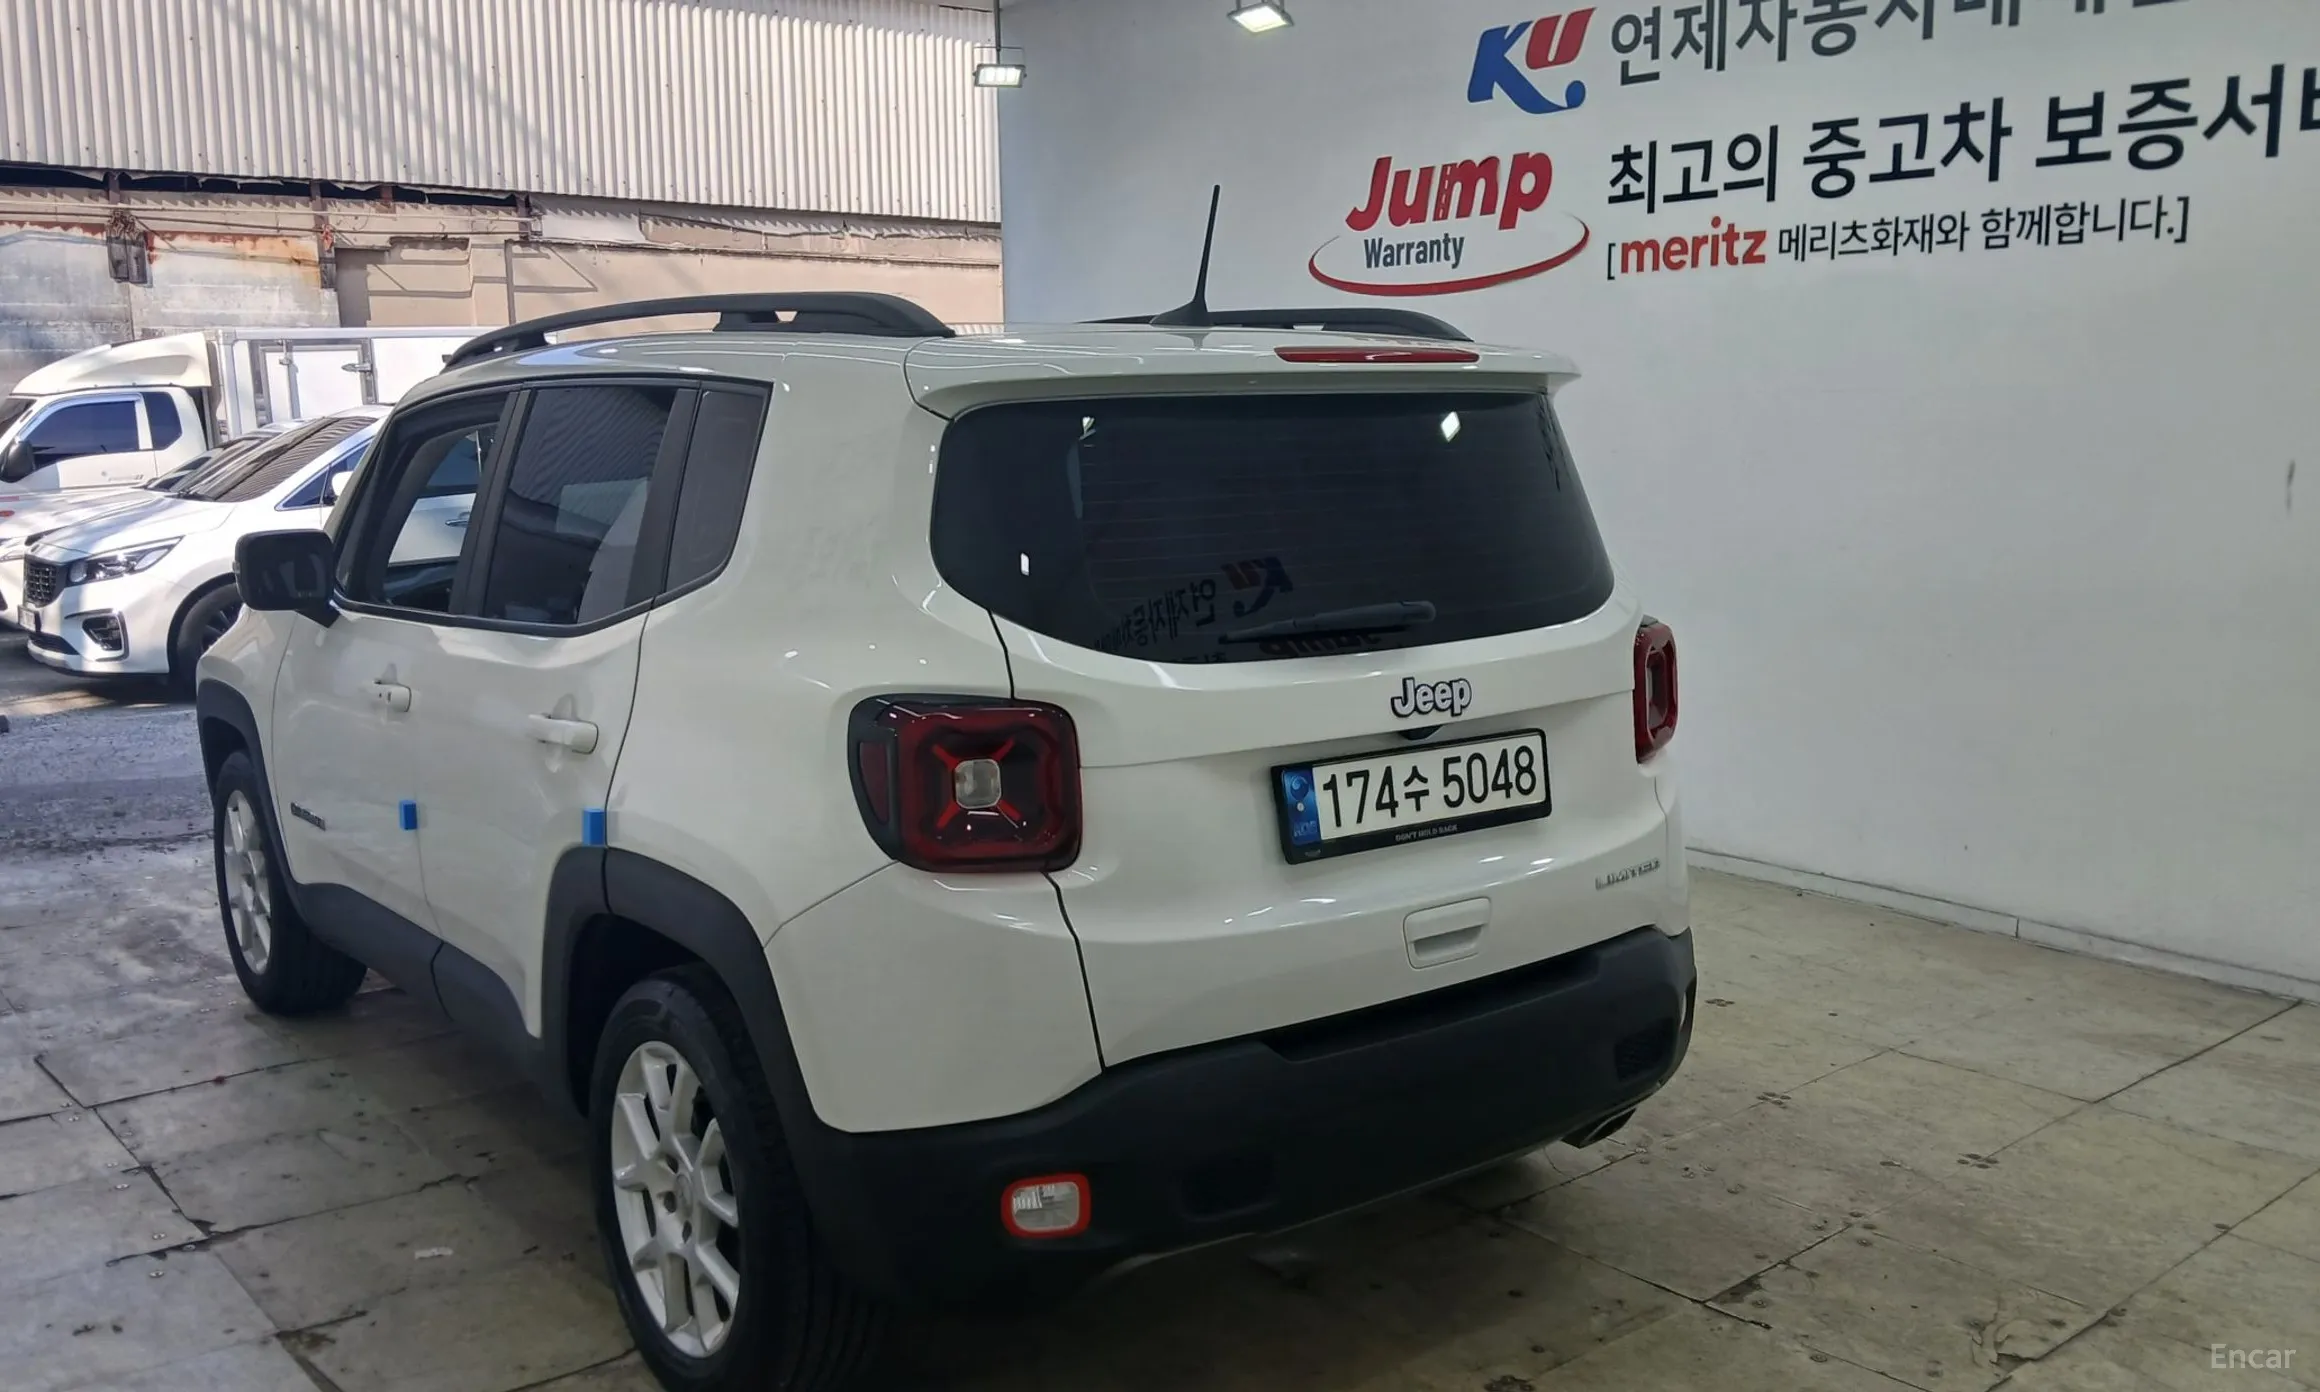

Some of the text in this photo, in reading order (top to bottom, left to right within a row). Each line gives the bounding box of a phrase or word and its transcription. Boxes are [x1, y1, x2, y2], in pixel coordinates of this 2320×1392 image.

[1607, 63, 2320, 214] 최고의 중고차 보증서
[1345, 152, 1553, 230] Jump
[1363, 232, 1465, 270] Warranty
[1778, 211, 1970, 262] 메리츠화재와
[1980, 195, 2190, 250] 함께합니다.]
[1390, 676, 1473, 718] Jeep
[1322, 745, 1537, 828] 174수 5048
